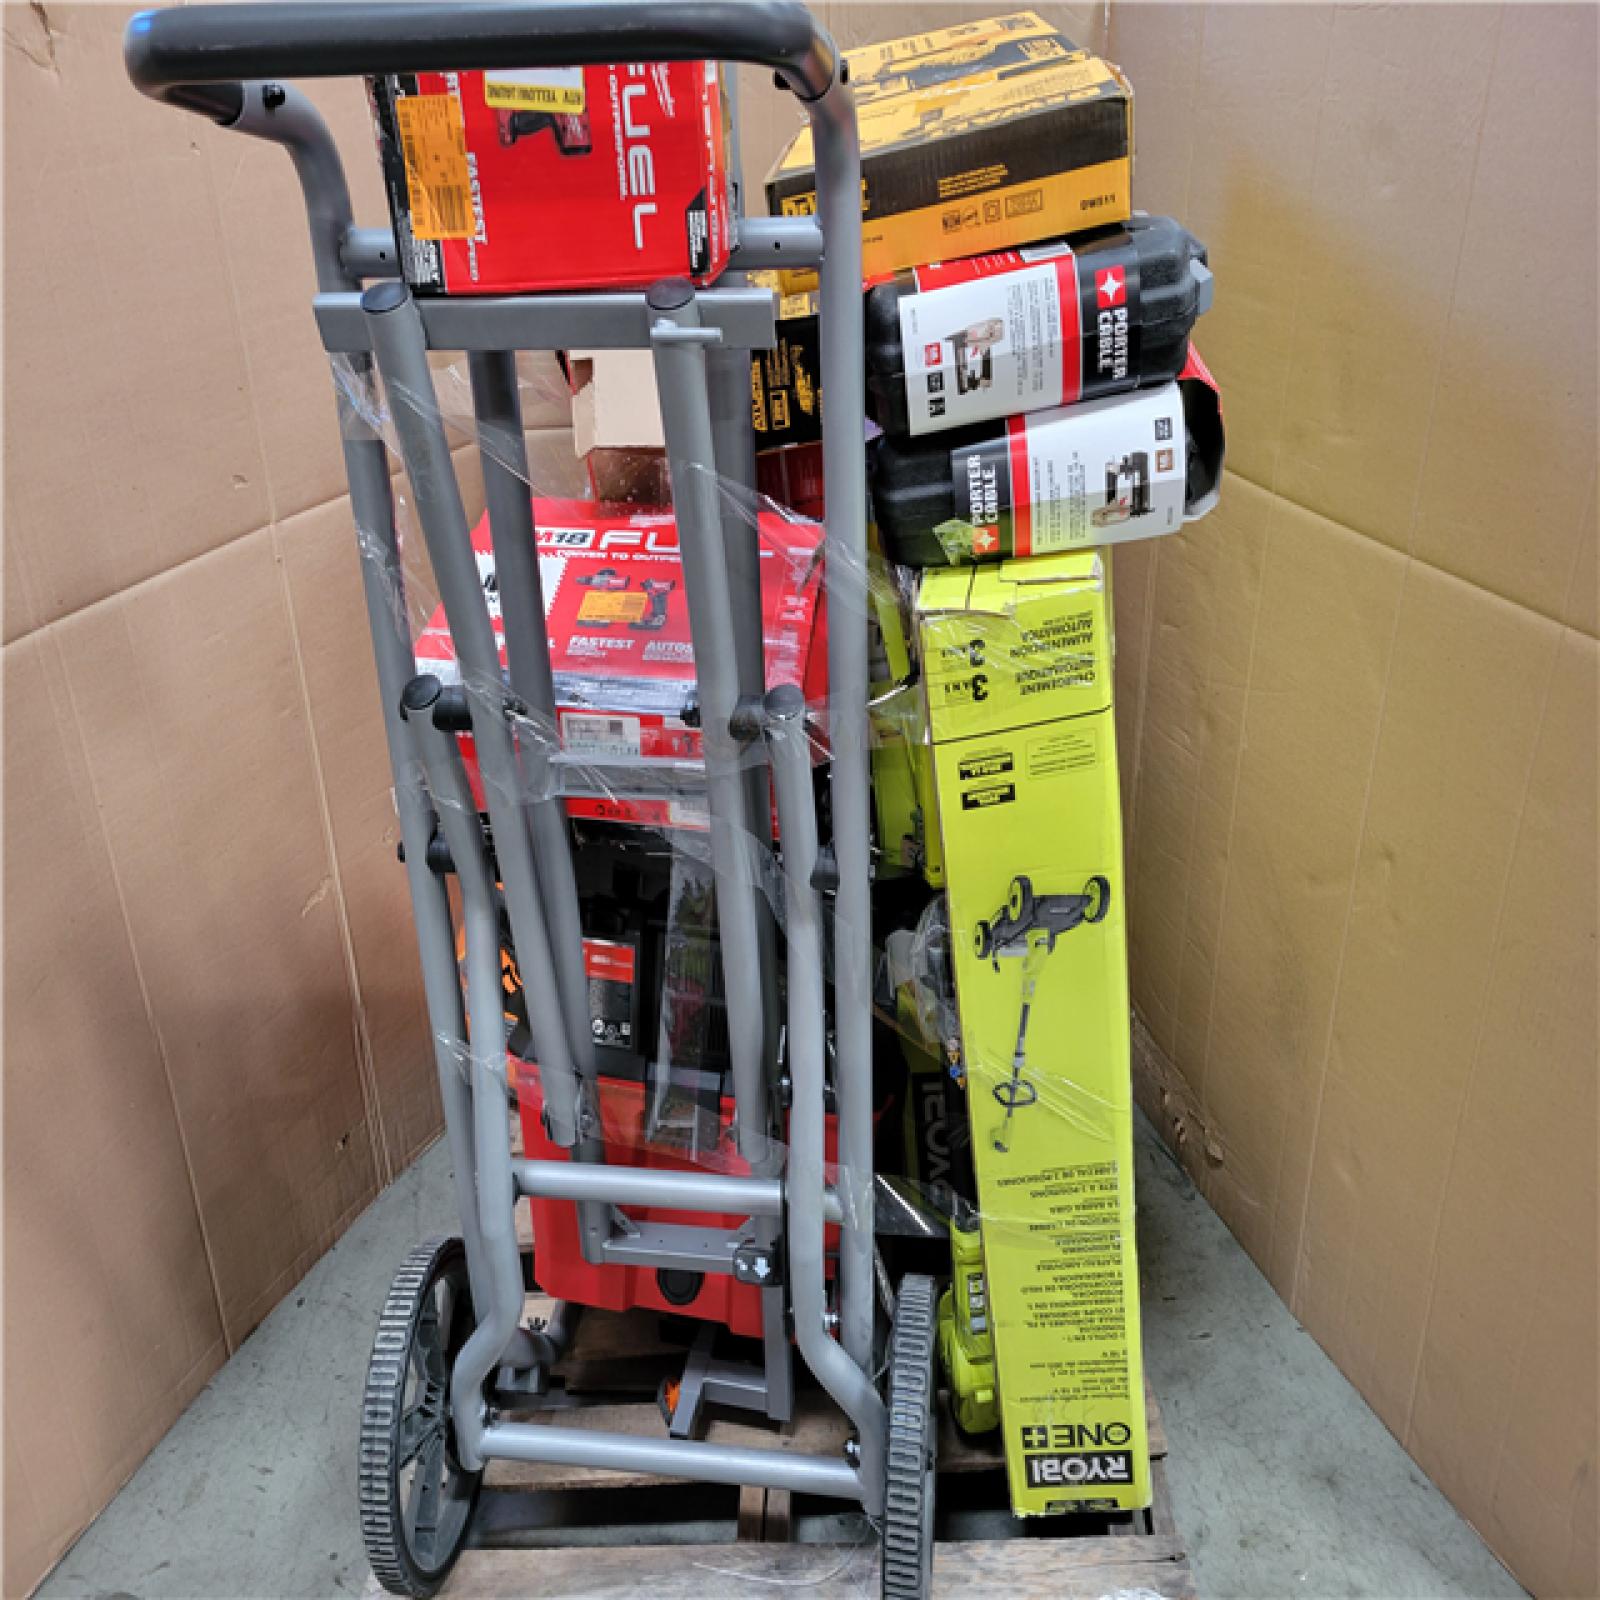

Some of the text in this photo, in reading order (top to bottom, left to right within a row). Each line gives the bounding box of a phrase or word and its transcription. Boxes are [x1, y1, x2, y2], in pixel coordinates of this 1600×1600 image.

[621, 64, 658, 249] UEL
[1097, 309, 1113, 374] CABLE
[1111, 307, 1129, 381] PORTER
[966, 454, 983, 526] PORTER
[981, 463, 1000, 525] CABLE
[971, 673, 989, 702] 3
[1032, 1455, 1129, 1484] RYOBI
